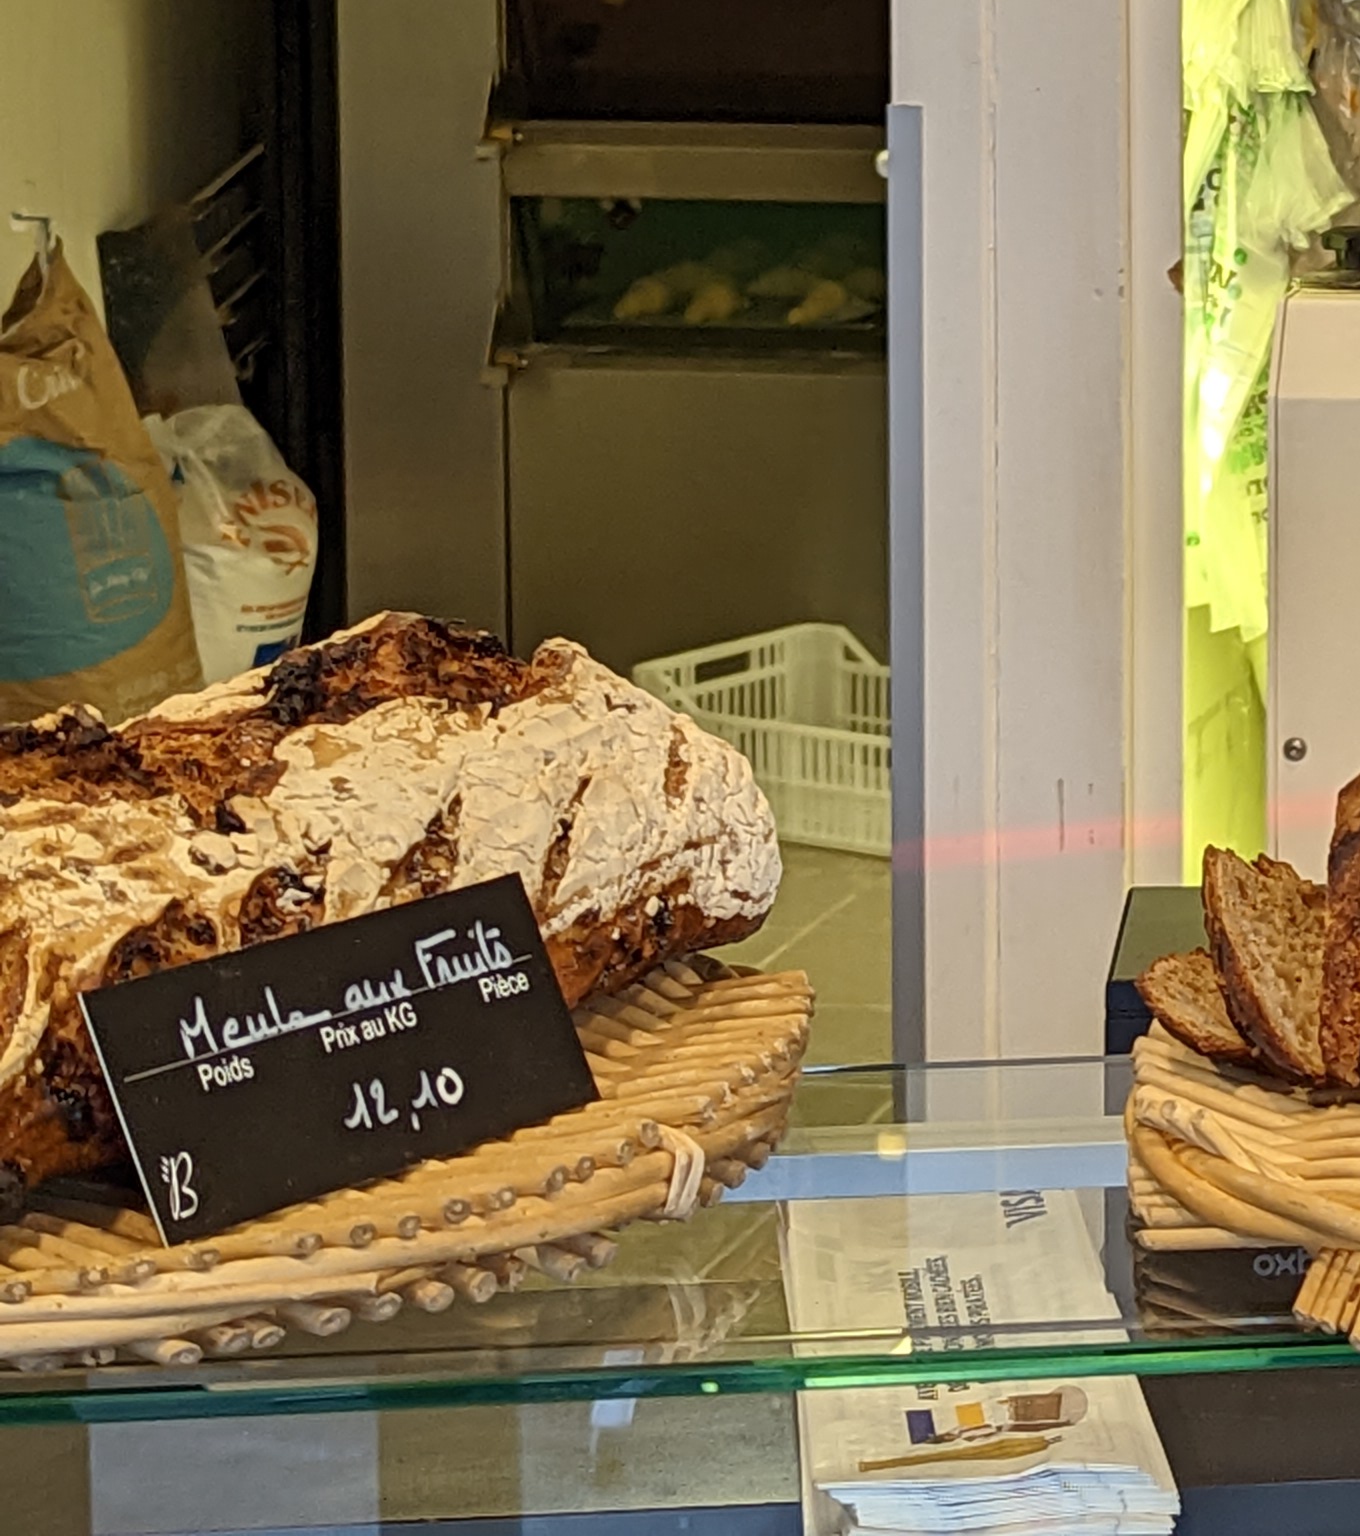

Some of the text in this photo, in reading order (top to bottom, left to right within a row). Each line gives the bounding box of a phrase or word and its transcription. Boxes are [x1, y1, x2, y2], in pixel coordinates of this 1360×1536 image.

[197, 971, 531, 1092] Poids Prix au KG Pièce
[342, 1066, 465, 1132] 12,10
